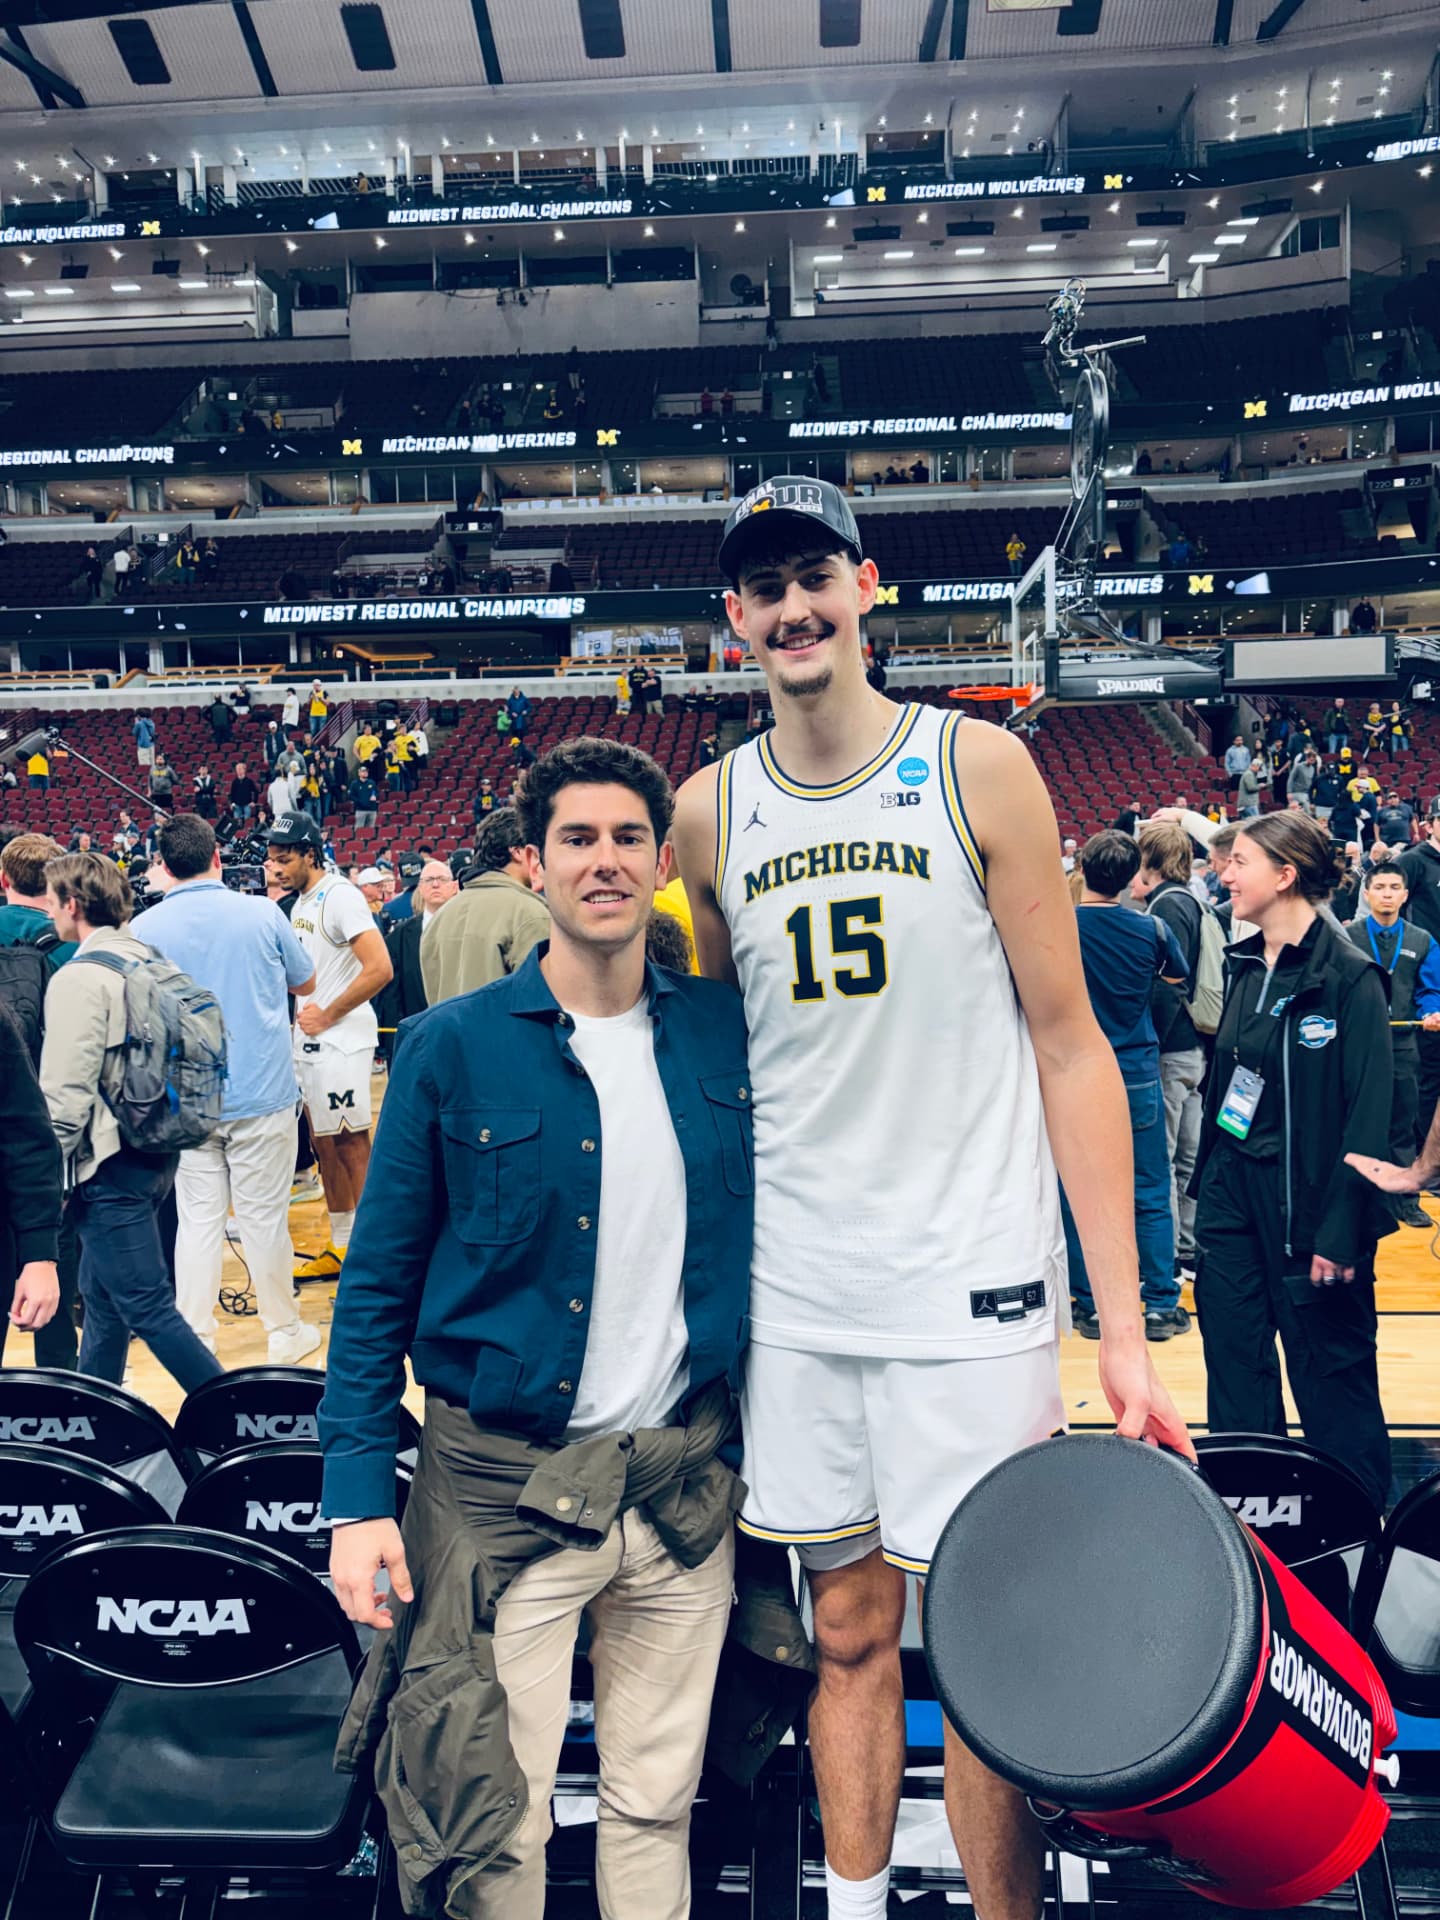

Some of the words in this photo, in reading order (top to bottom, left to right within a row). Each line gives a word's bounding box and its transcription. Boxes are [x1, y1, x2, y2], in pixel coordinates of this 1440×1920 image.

[1373, 135, 1440, 162] MIDWE
[904, 183, 985, 200] MICHIGAN
[988, 176, 1085, 195] WOLVERINES
[387, 207, 459, 224] MIDWEST
[462, 202, 537, 220] REGIONAL
[540, 199, 633, 218] CHAMPIONS
[35, 223, 126, 242] WOLVERINES
[1289, 387, 1390, 412] MICHIGAN
[1394, 381, 1440, 400] WOLV
[789, 420, 869, 437] MIDWEST
[872, 415, 957, 433] REGIONAL
[961, 412, 1066, 430] CHAMPIONS
[75, 445, 174, 463] CHAMPIONS
[382, 436, 469, 453] MICHIGAN
[471, 431, 577, 452] WOLVERINES
[923, 582, 1021, 602] MICHIGA
[264, 605, 358, 623] MIDWEST
[361, 600, 460, 620] REGIONAL
[464, 597, 586, 619] CHAMPIONS
[1097, 677, 1165, 696] SPALDING
[743, 841, 932, 904] MICHIGAN
[785, 894, 890, 1003] 15
[327, 1089, 355, 1110] M
[235, 1413, 320, 1439] NCA
[0, 1504, 85, 1536] CAA
[96, 1596, 251, 1636] NCAA
[1270, 1630, 1372, 1770] BODYARMOR
